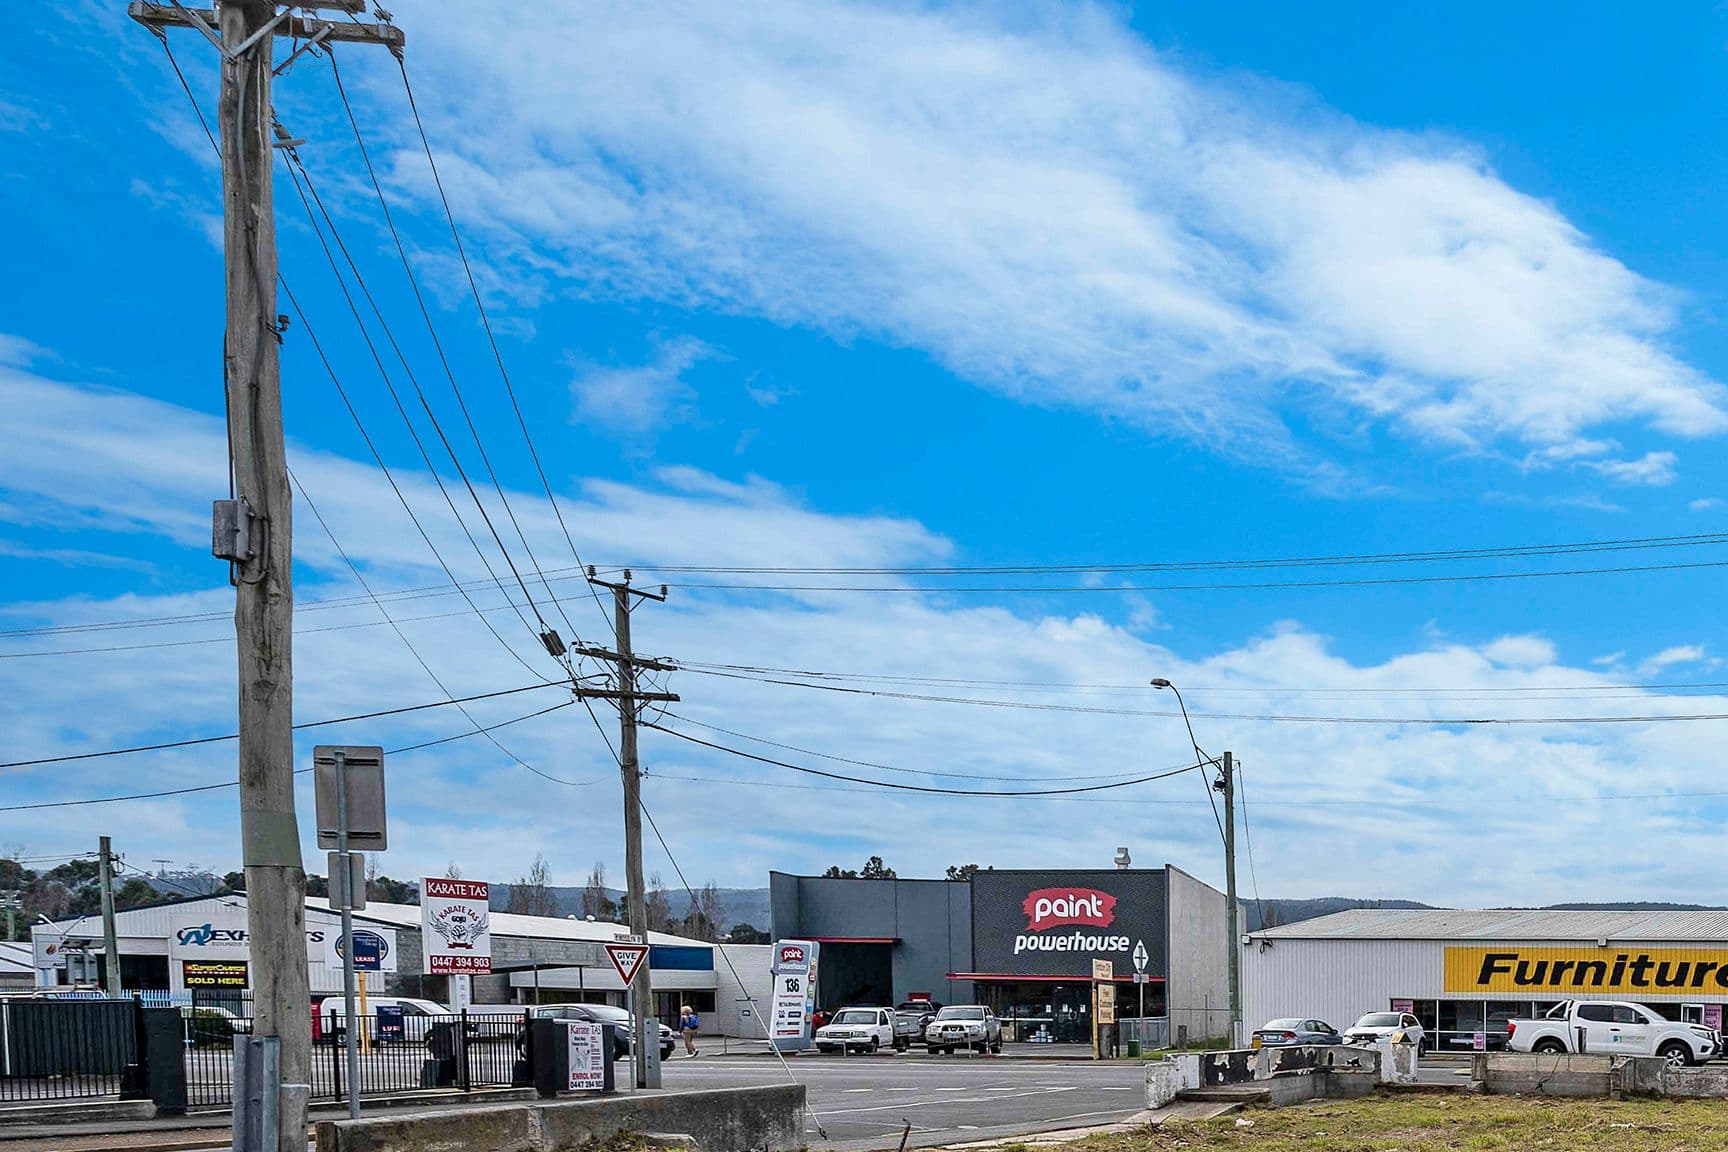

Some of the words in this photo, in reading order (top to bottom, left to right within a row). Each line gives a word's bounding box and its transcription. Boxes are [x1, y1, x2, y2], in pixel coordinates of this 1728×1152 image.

[428, 882, 467, 895] KARATE
[469, 886, 487, 896] TAS
[438, 904, 466, 919] KARATE
[467, 908, 479, 921] TAS
[1035, 894, 1103, 922] paint
[1014, 931, 1130, 954] powerhouse
[617, 952, 637, 960] GIVE
[784, 949, 802, 960] paint
[432, 956, 453, 966] 0447
[456, 957, 472, 967] 394
[473, 958, 490, 968] 903
[187, 977, 216, 985] SOLD
[217, 977, 246, 985] HERE
[785, 978, 800, 993] 136
[590, 1025, 602, 1034] TAS
